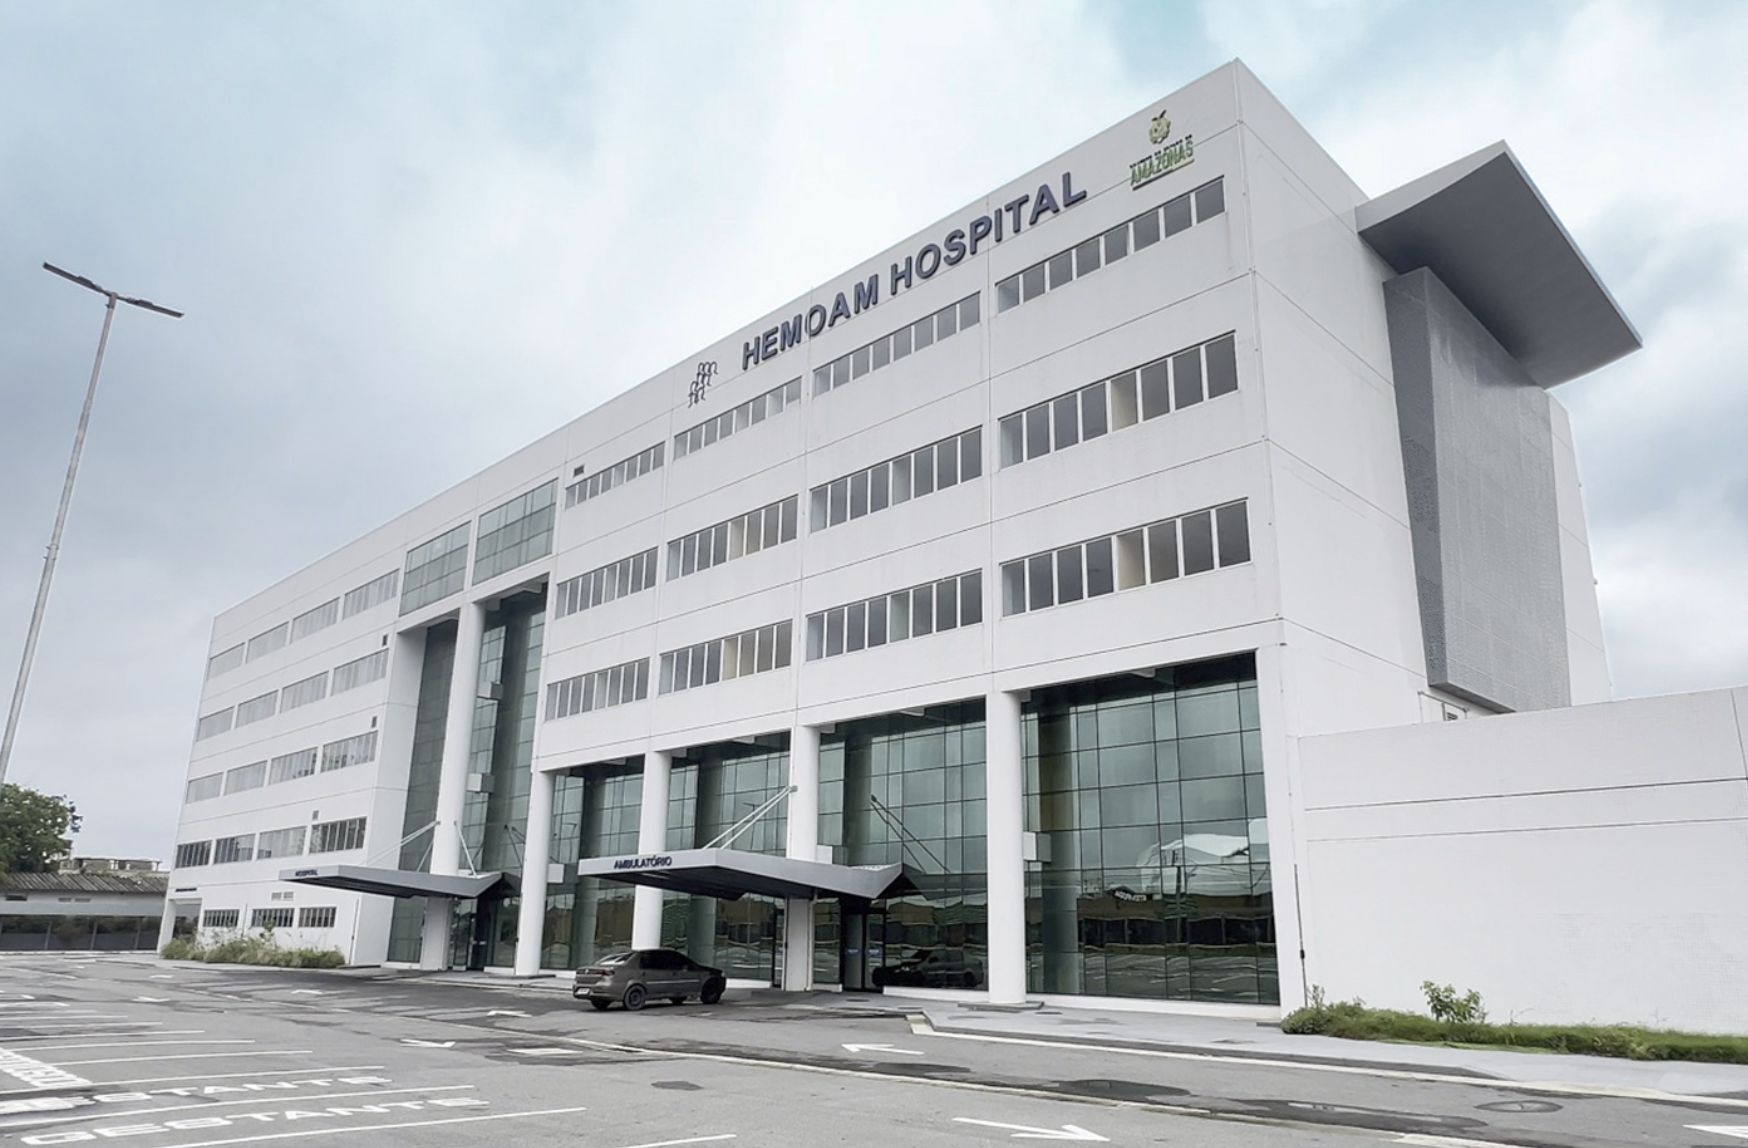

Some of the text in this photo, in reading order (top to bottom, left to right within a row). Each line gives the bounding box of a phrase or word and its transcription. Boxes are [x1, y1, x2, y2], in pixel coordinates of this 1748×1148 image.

[1130, 139, 1194, 186] AMAZONAS
[742, 171, 1088, 370] HEMOAM HOSPITAL
[613, 855, 673, 869] AMBULATÓRIO
